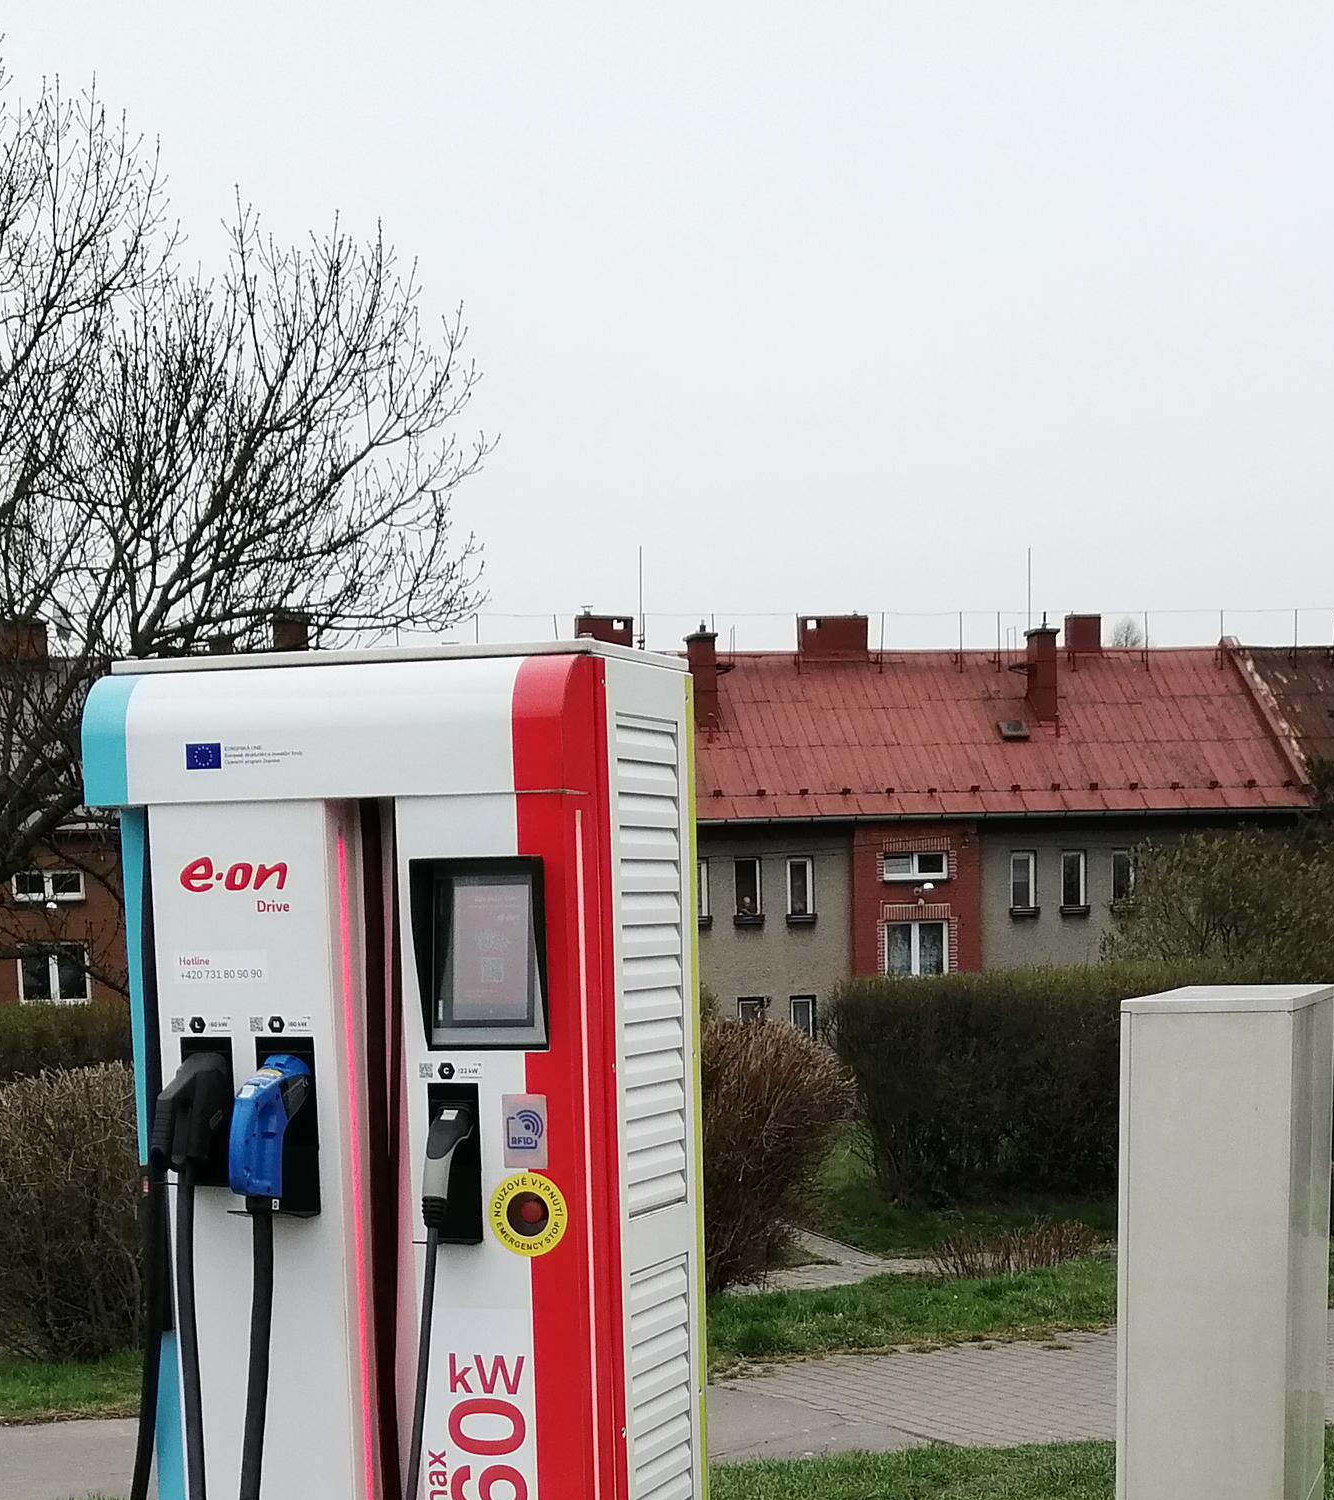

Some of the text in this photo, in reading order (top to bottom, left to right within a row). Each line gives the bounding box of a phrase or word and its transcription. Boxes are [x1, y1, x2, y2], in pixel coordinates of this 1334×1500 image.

[257, 900, 290, 912] Drive
[179, 956, 210, 966] Hotline
[180, 970, 203, 980] +420
[205, 969, 221, 979] 731
[251, 968, 263, 978] 90
[194, 1021, 201, 1029] L
[443, 1067, 450, 1075] C
[511, 1136, 534, 1145] RFID
[493, 1175, 528, 1218] NOUZOVÉ
[496, 1221, 561, 1251] EMERGENCY STOP
[448, 1353, 525, 1395] kW
